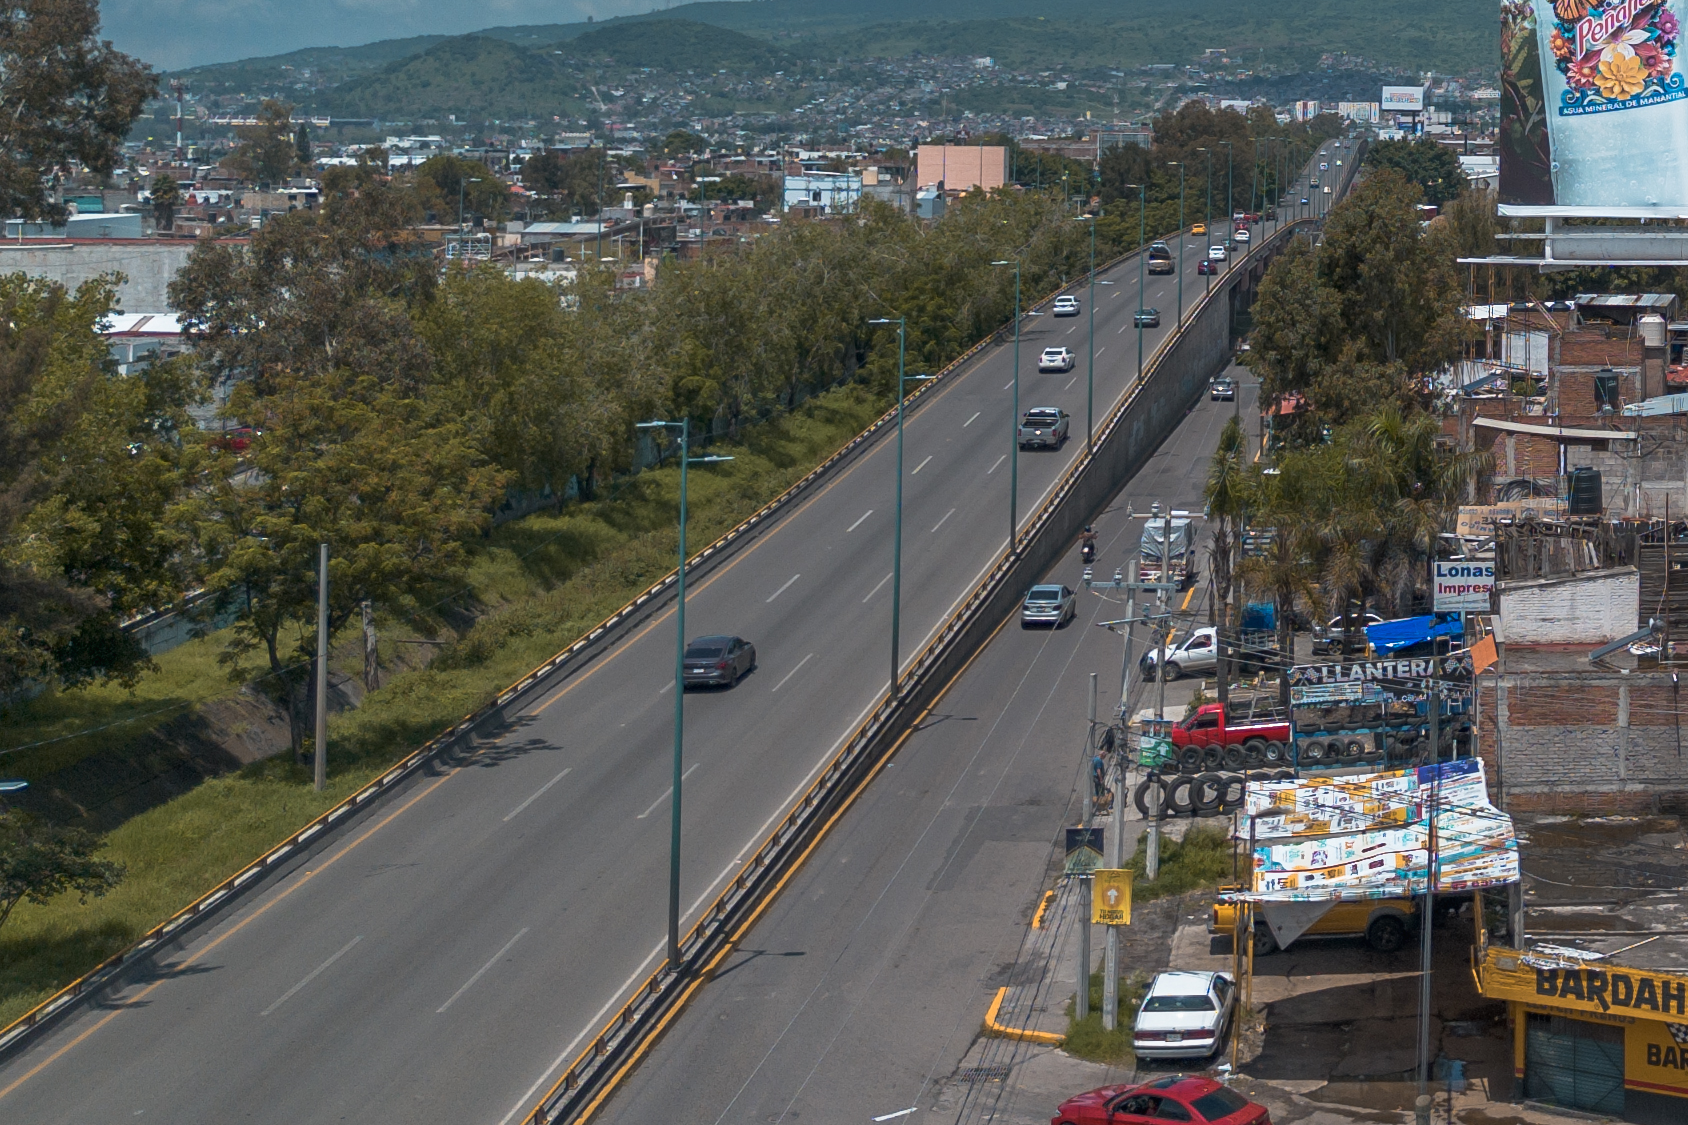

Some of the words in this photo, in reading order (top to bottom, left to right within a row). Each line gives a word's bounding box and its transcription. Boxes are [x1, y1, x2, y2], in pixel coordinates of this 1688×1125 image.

[1562, 106, 1583, 115] AGUA
[1585, 102, 1625, 113] MINERAL
[1626, 99, 1638, 108] DE
[1640, 90, 1686, 105] MANANTIAL
[1436, 563, 1495, 578] Lonas
[1438, 582, 1494, 596] Impres
